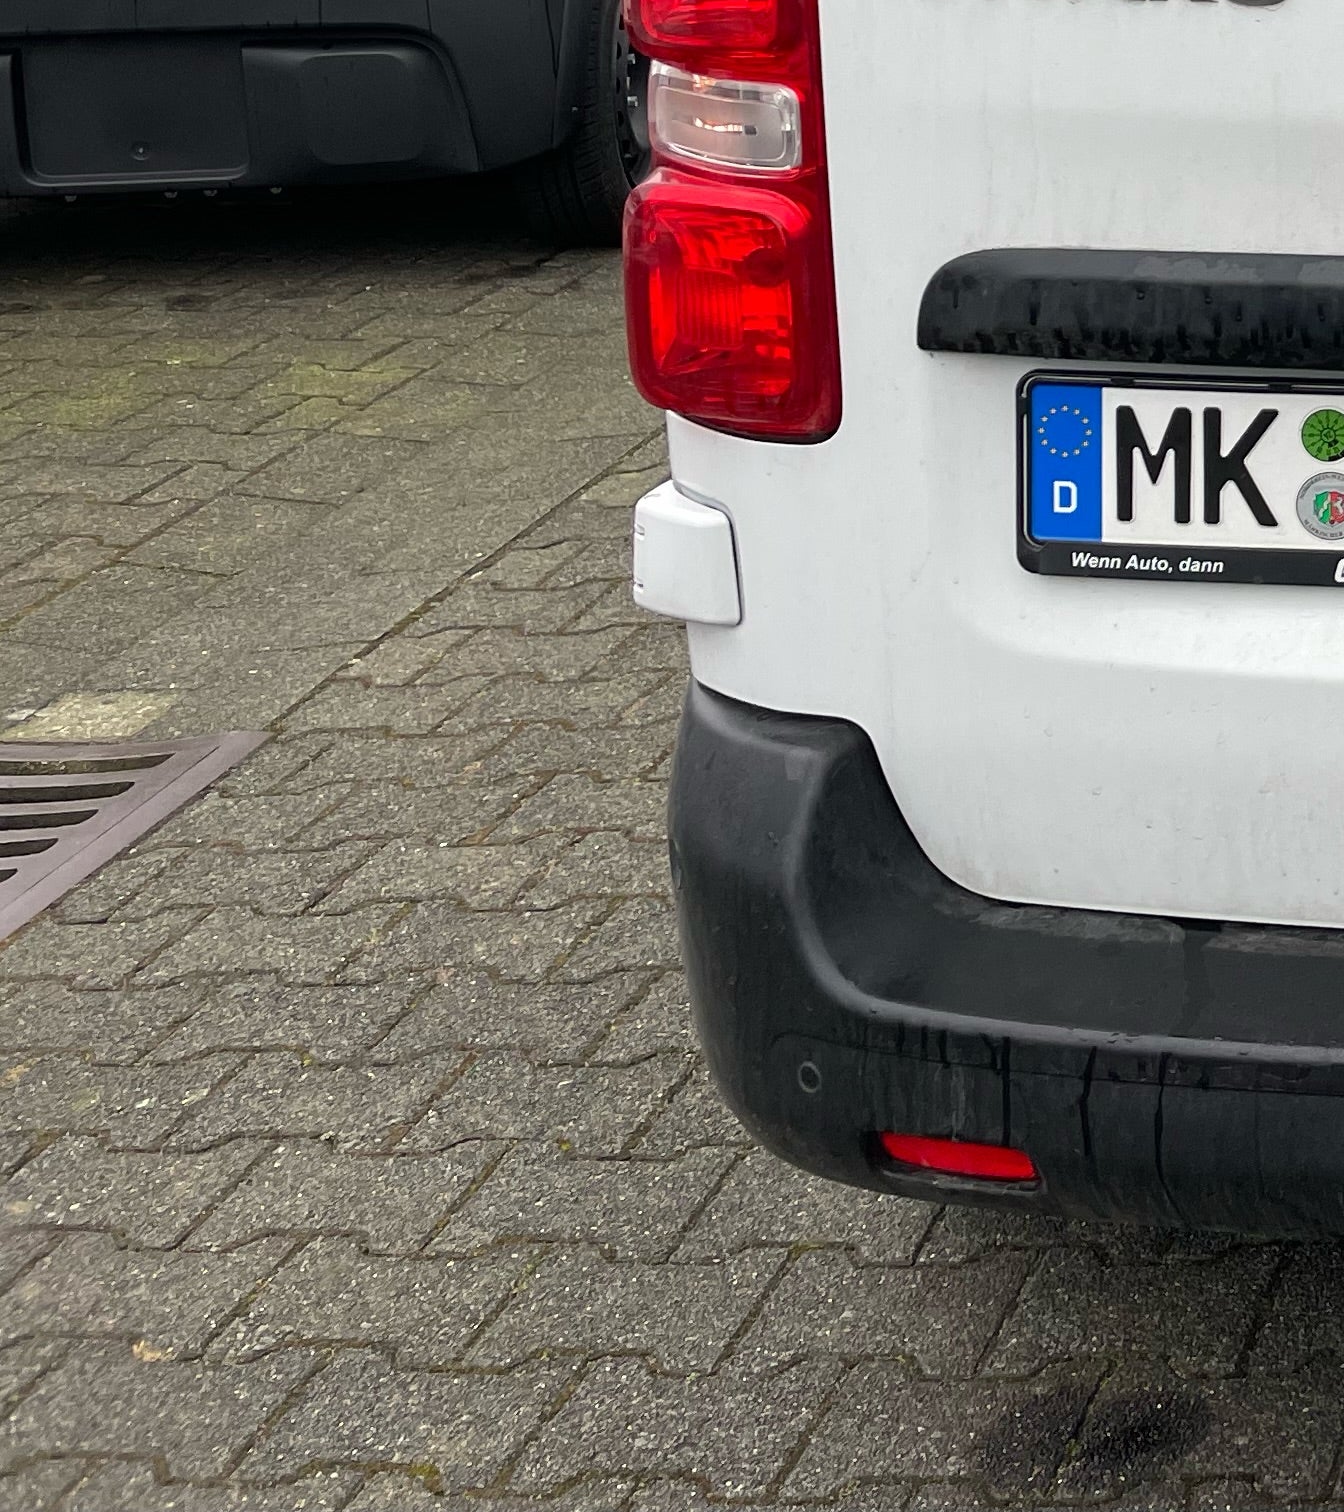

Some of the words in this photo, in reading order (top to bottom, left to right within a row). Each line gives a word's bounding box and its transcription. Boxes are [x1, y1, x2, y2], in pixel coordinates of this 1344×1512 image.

[1116, 406, 1278, 527] MK
[1054, 481, 1077, 512] D
[1072, 552, 1121, 568] Wenn
[1125, 555, 1172, 573] Auto,
[1179, 557, 1223, 572] dann
